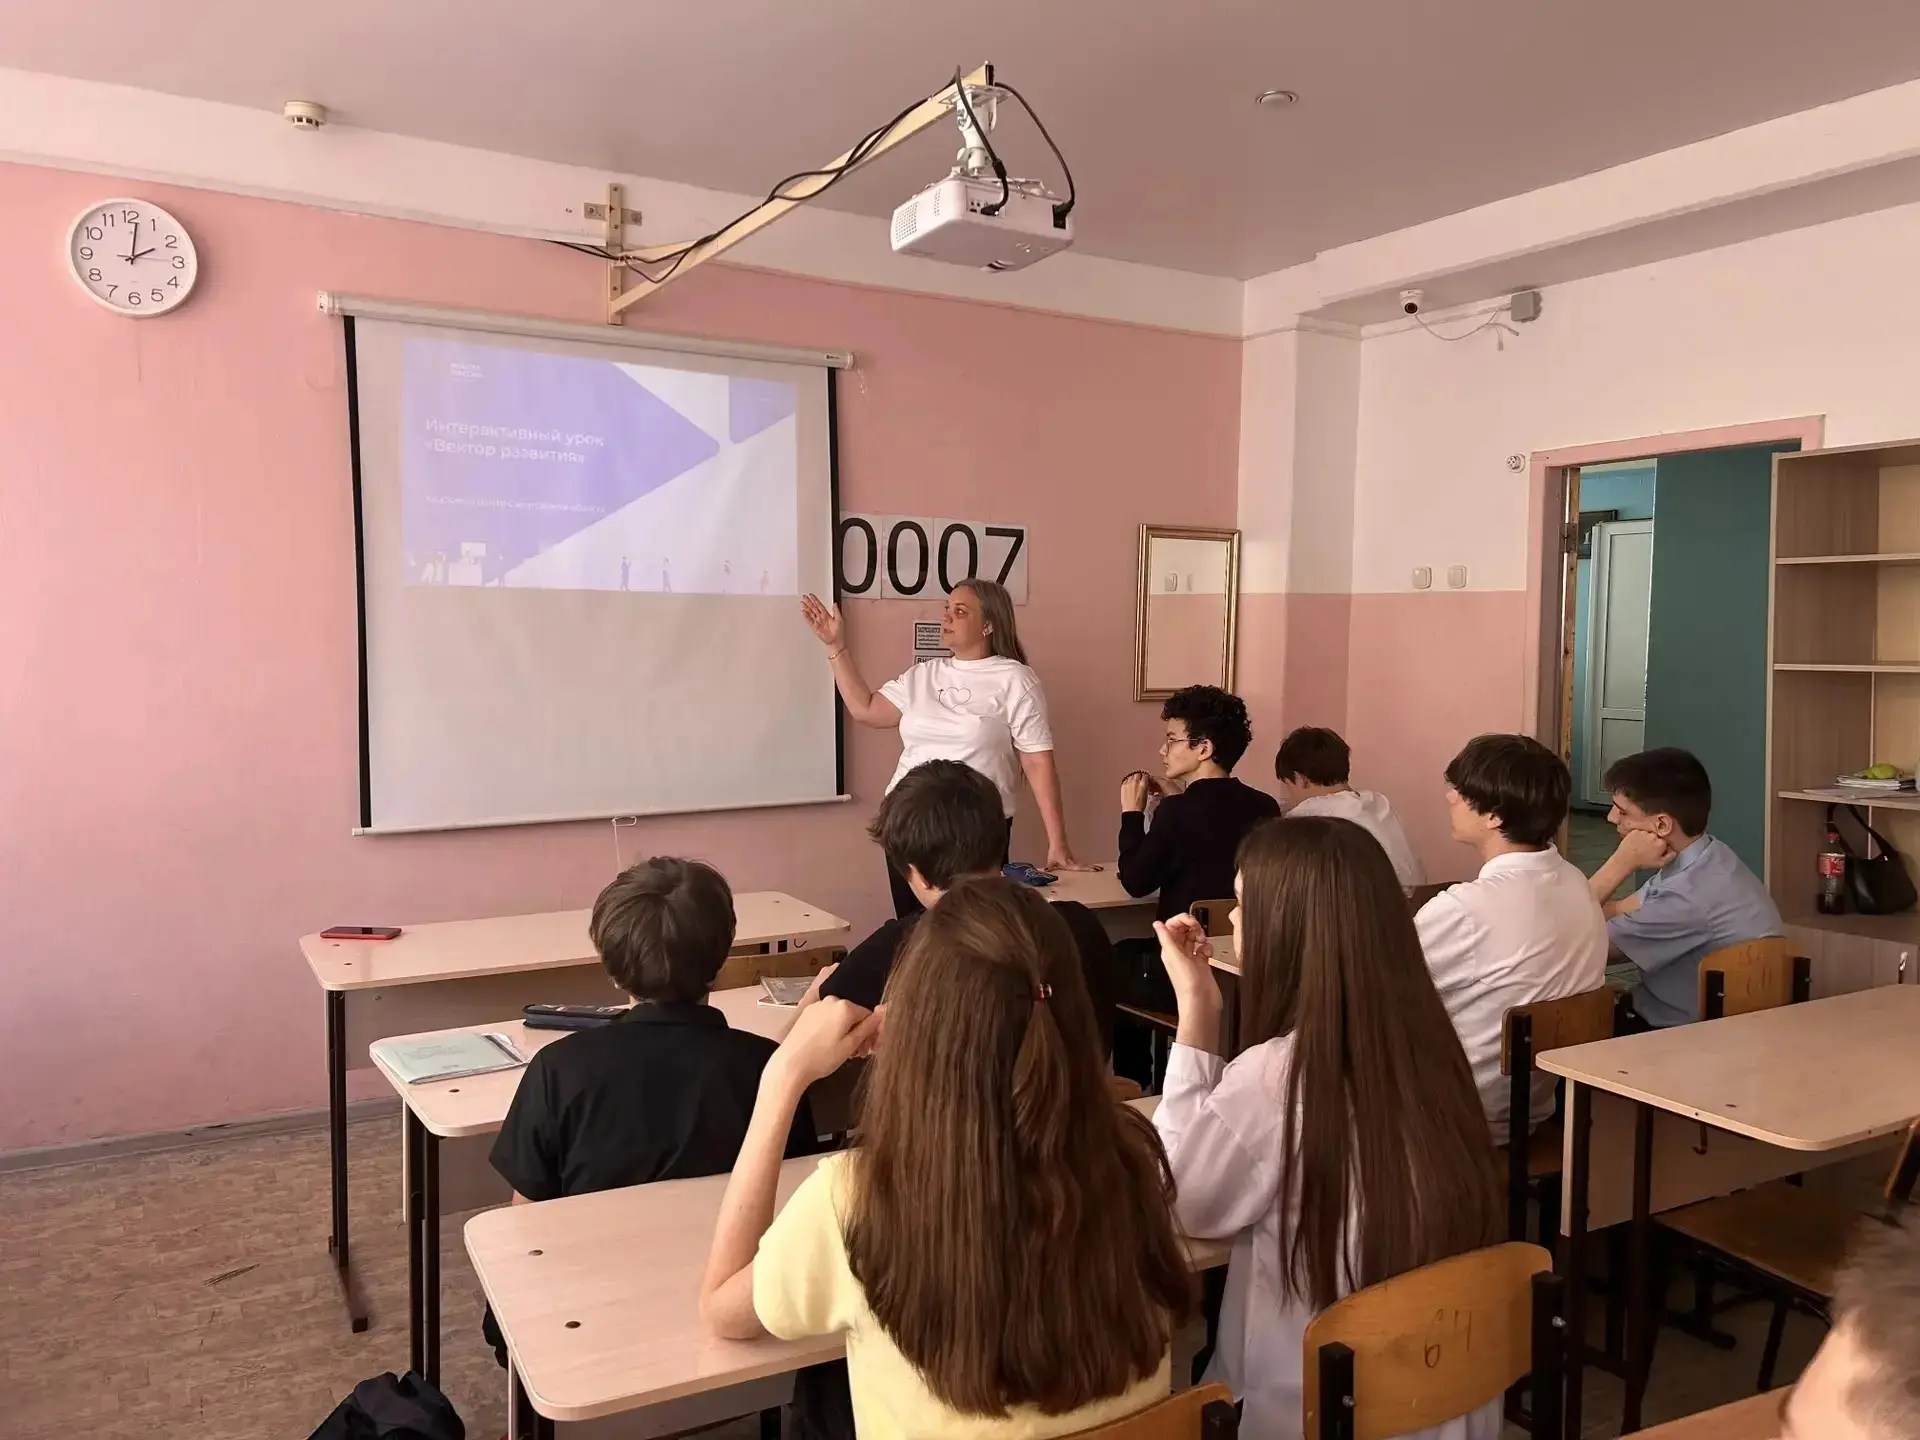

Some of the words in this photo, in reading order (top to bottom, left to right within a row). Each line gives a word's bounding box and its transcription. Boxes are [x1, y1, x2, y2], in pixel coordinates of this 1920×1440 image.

[102, 213, 114, 227] 11
[122, 210, 139, 224] 12
[151, 218, 156, 231] 1
[86, 226, 103, 240] 10
[165, 235, 178, 248] 2
[80, 247, 93, 260] 9
[172, 256, 185, 269] 3
[89, 268, 102, 281] 8
[167, 276, 179, 288] 4
[107, 284, 118, 297] 7
[151, 289, 163, 302] 5
[128, 292, 141, 305] 6
[425, 418, 561, 442] Интерактивный
[565, 434, 605, 447] урок
